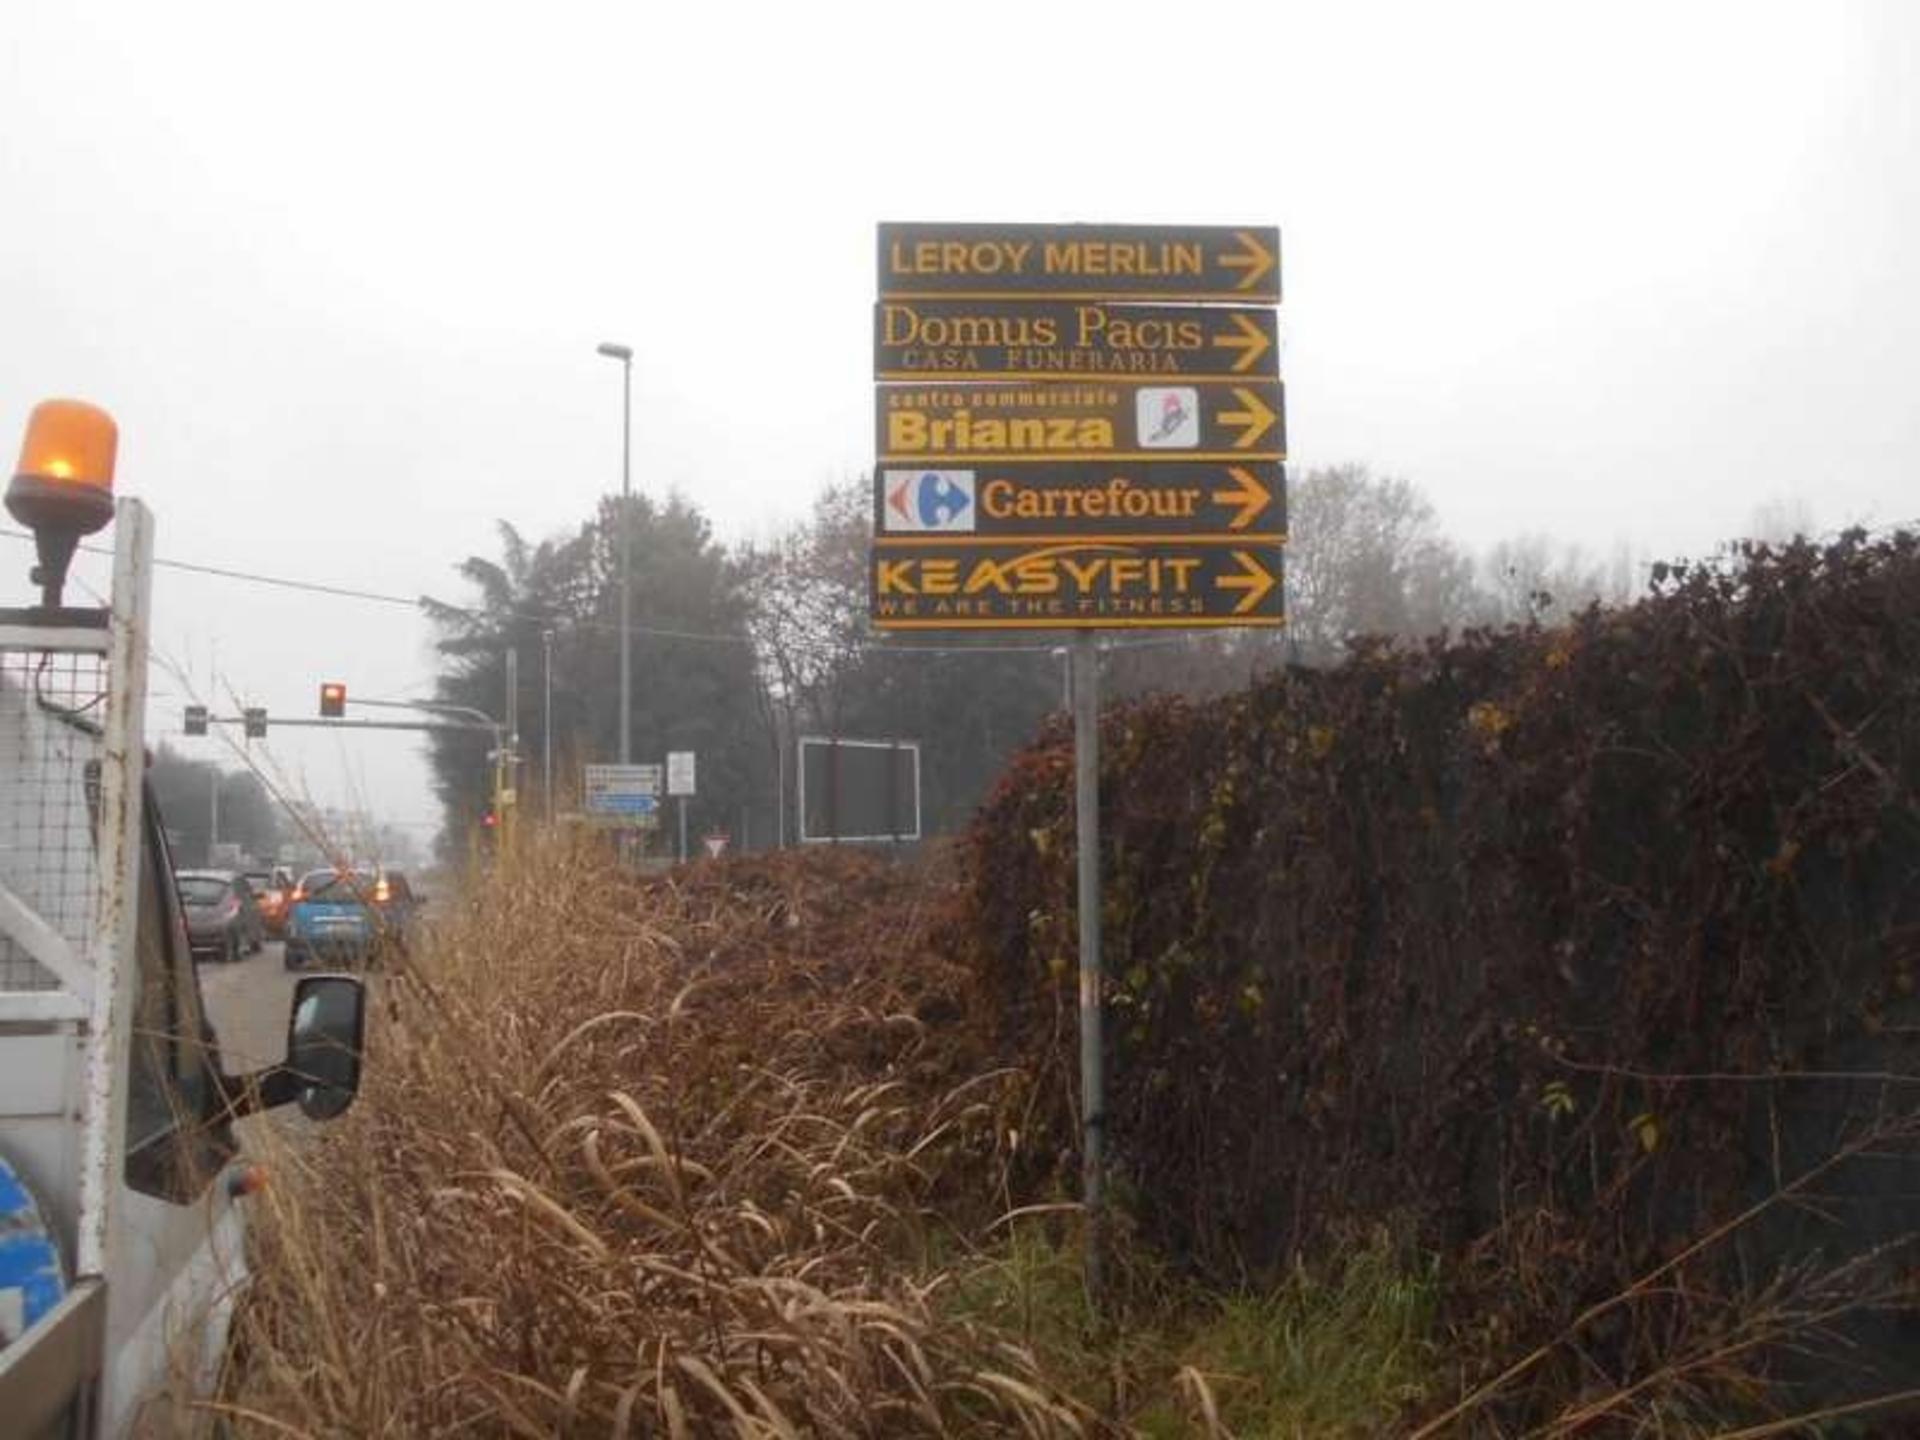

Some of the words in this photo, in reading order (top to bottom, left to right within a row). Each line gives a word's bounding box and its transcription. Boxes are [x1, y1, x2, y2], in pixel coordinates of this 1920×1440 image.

[891, 242, 1032, 274] LEROY
[1044, 242, 1202, 275] MERLIN
[882, 306, 1057, 347] Domus
[902, 349, 979, 369] CASA
[1006, 348, 1180, 372] FUNERARIA
[888, 410, 1115, 449] Brianza
[982, 479, 1201, 518] Carrefour
[877, 557, 1203, 594] KEASYFIT
[879, 599, 917, 615] WE
[936, 599, 993, 615] ARE
[1009, 599, 1064, 615] THE
